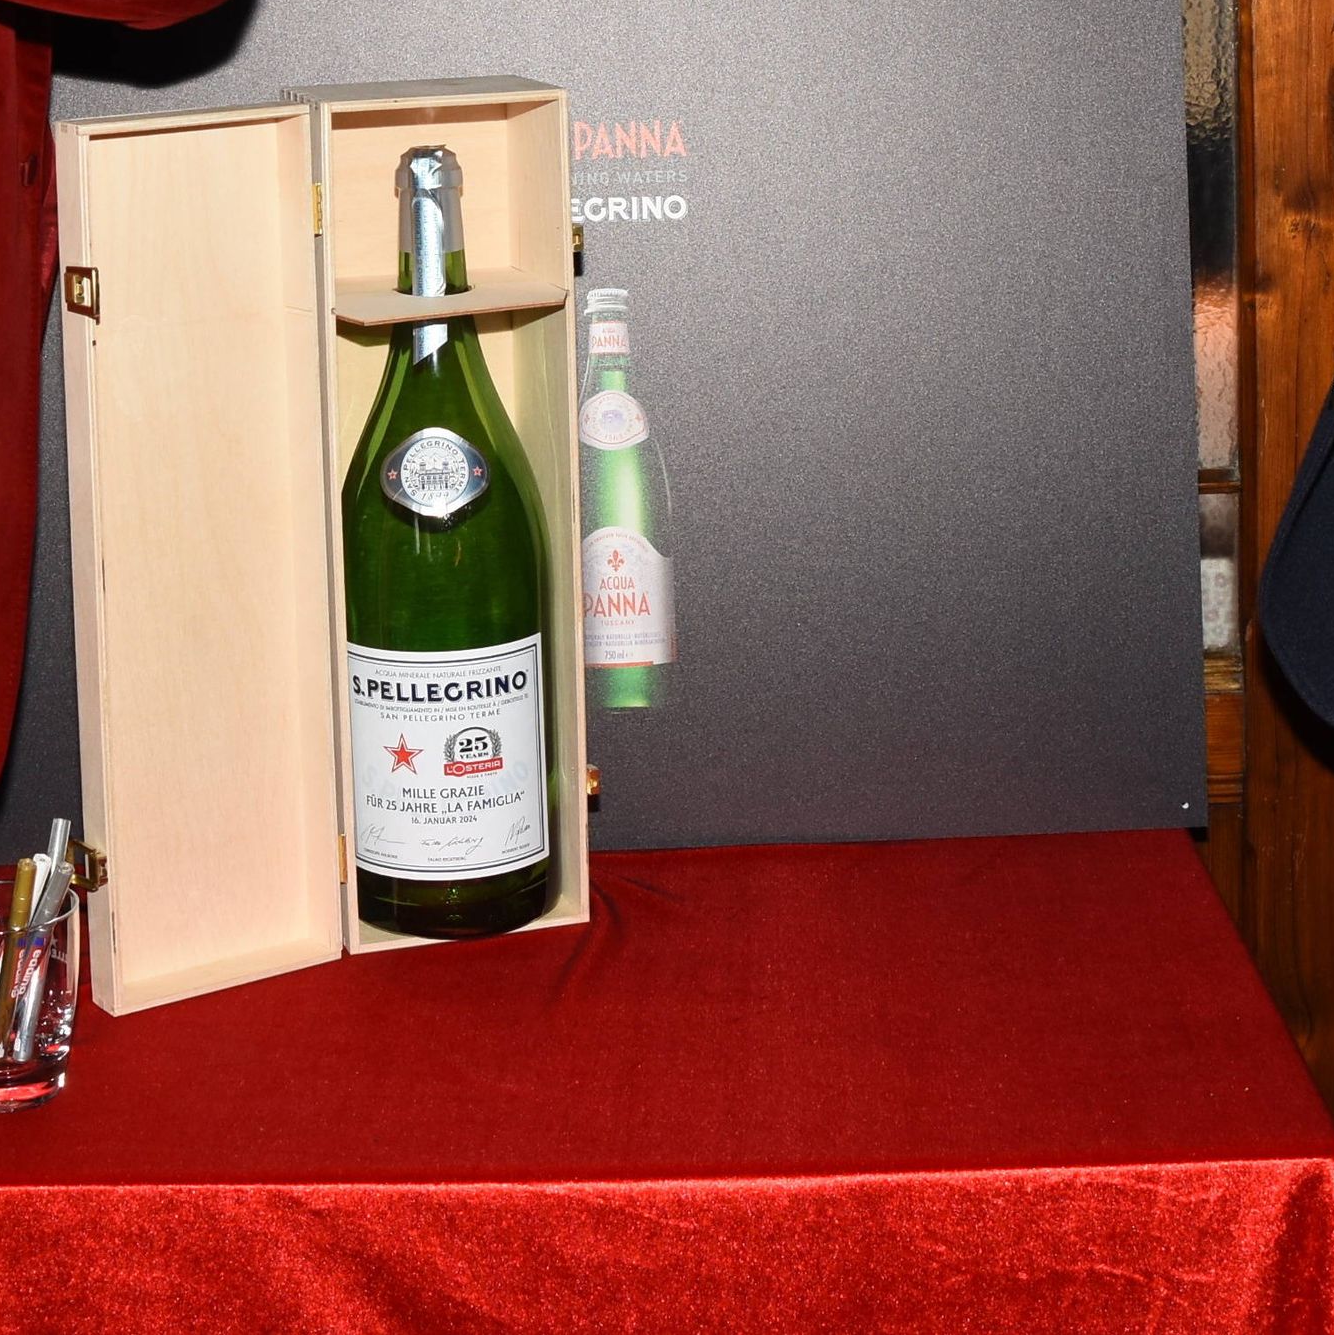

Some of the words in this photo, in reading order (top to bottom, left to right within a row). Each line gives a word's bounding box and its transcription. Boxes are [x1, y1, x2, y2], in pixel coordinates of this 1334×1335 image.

[573, 119, 688, 161] PANNA
[616, 169, 688, 184] WATERS
[570, 194, 688, 222] EGRINO
[403, 440, 459, 471] PELLEGRINO
[453, 457, 467, 493] TERME
[404, 476, 418, 497] SAN
[599, 575, 636, 591] ACQUA
[583, 591, 652, 618] PANNA
[374, 668, 397, 678] ACQUA
[398, 671, 430, 679] MINERALE
[432, 669, 466, 679] NATURALE
[468, 665, 502, 676] FRIZZANTE
[352, 670, 528, 703] S.PELLEGRINO
[380, 711, 399, 720] SAN
[403, 712, 466, 722] PELLEGRINO
[469, 708, 501, 720] TERME
[458, 735, 489, 753] 25
[459, 752, 489, 760] YEARS
[402, 787, 437, 799] MILLE
[439, 784, 485, 799] GRAZIE
[366, 793, 384, 808] FÜR
[385, 799, 397, 811] 25
[399, 801, 438, 814] JAHRE
[411, 816, 421, 825] 16.
[422, 815, 457, 825] JANUAR
[459, 814, 478, 824] 2024
[18, 949, 43, 995] edding
